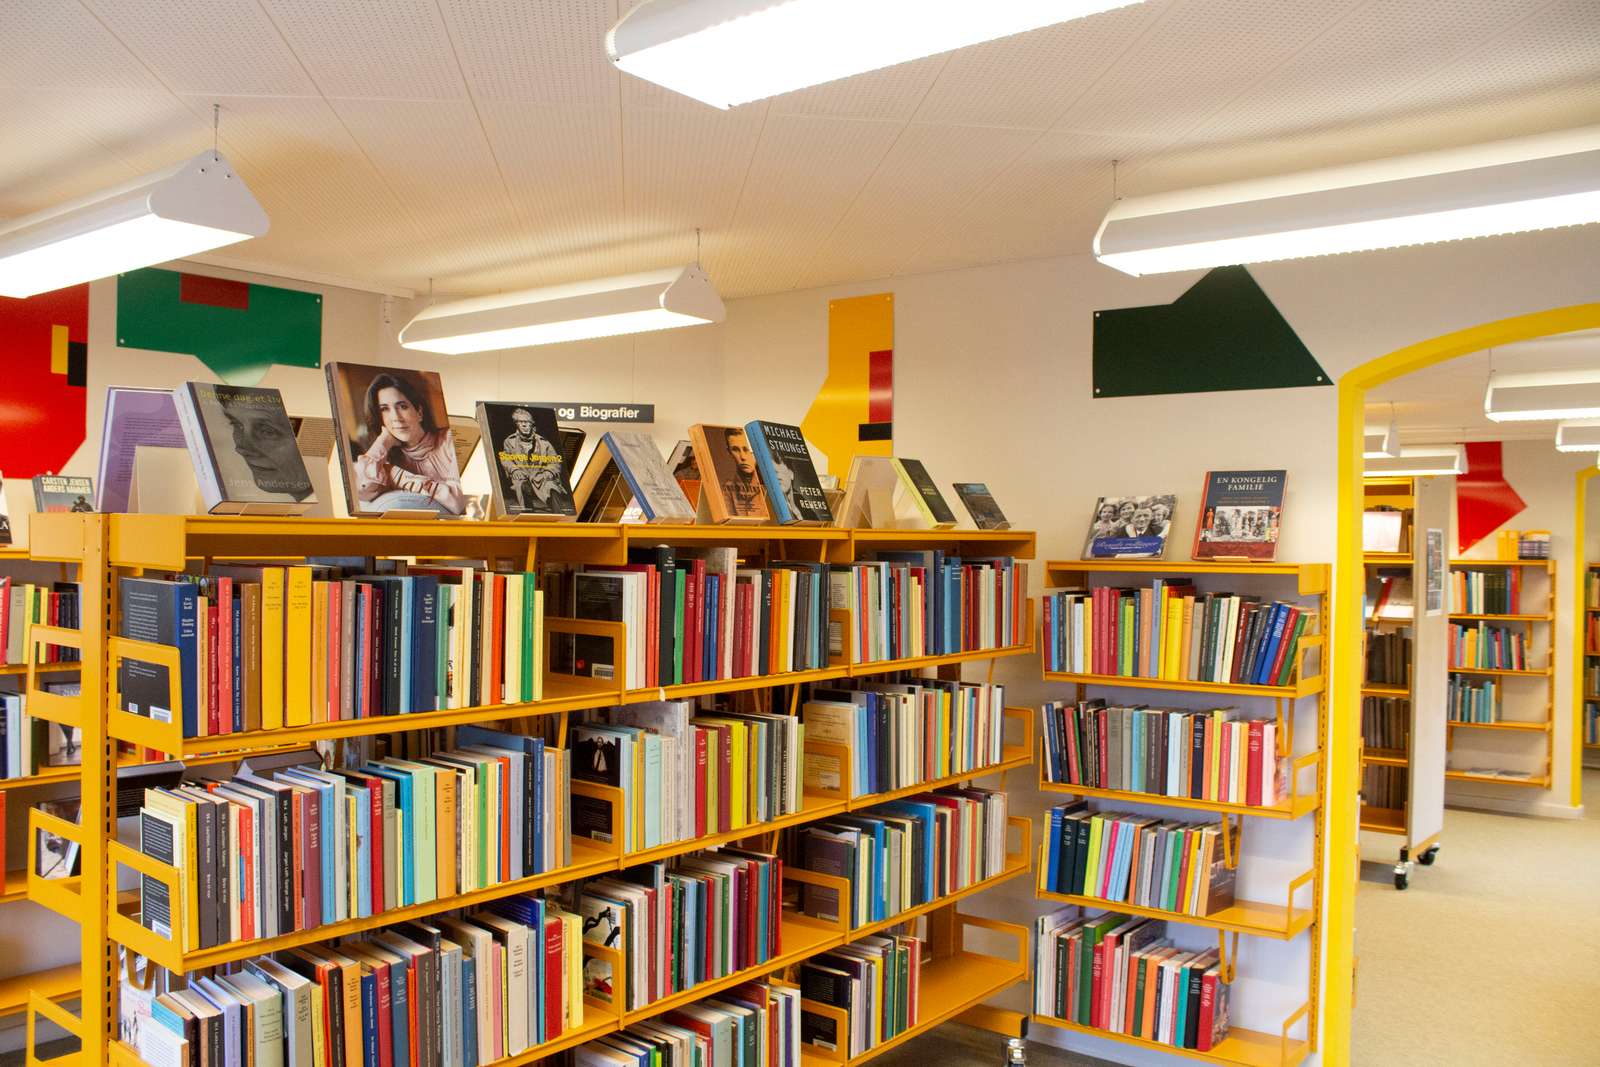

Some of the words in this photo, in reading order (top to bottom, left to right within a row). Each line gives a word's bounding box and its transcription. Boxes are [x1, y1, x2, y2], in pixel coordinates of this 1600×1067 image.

[558, 408, 575, 419] og
[580, 406, 640, 419] Biografier
[763, 425, 802, 441] MICHAEL
[768, 439, 808, 455] STRUNGE
[41, 476, 67, 487] CARSTEN
[69, 478, 91, 487] JENSEN
[257, 479, 311, 489] Andersen
[1216, 476, 1228, 484] EN
[1231, 475, 1278, 484] KONGELIG
[43, 485, 66, 494] ANDERS
[799, 486, 823, 498] PETER
[1227, 483, 1264, 491] FAMILIE
[799, 499, 828, 511] REWERS
